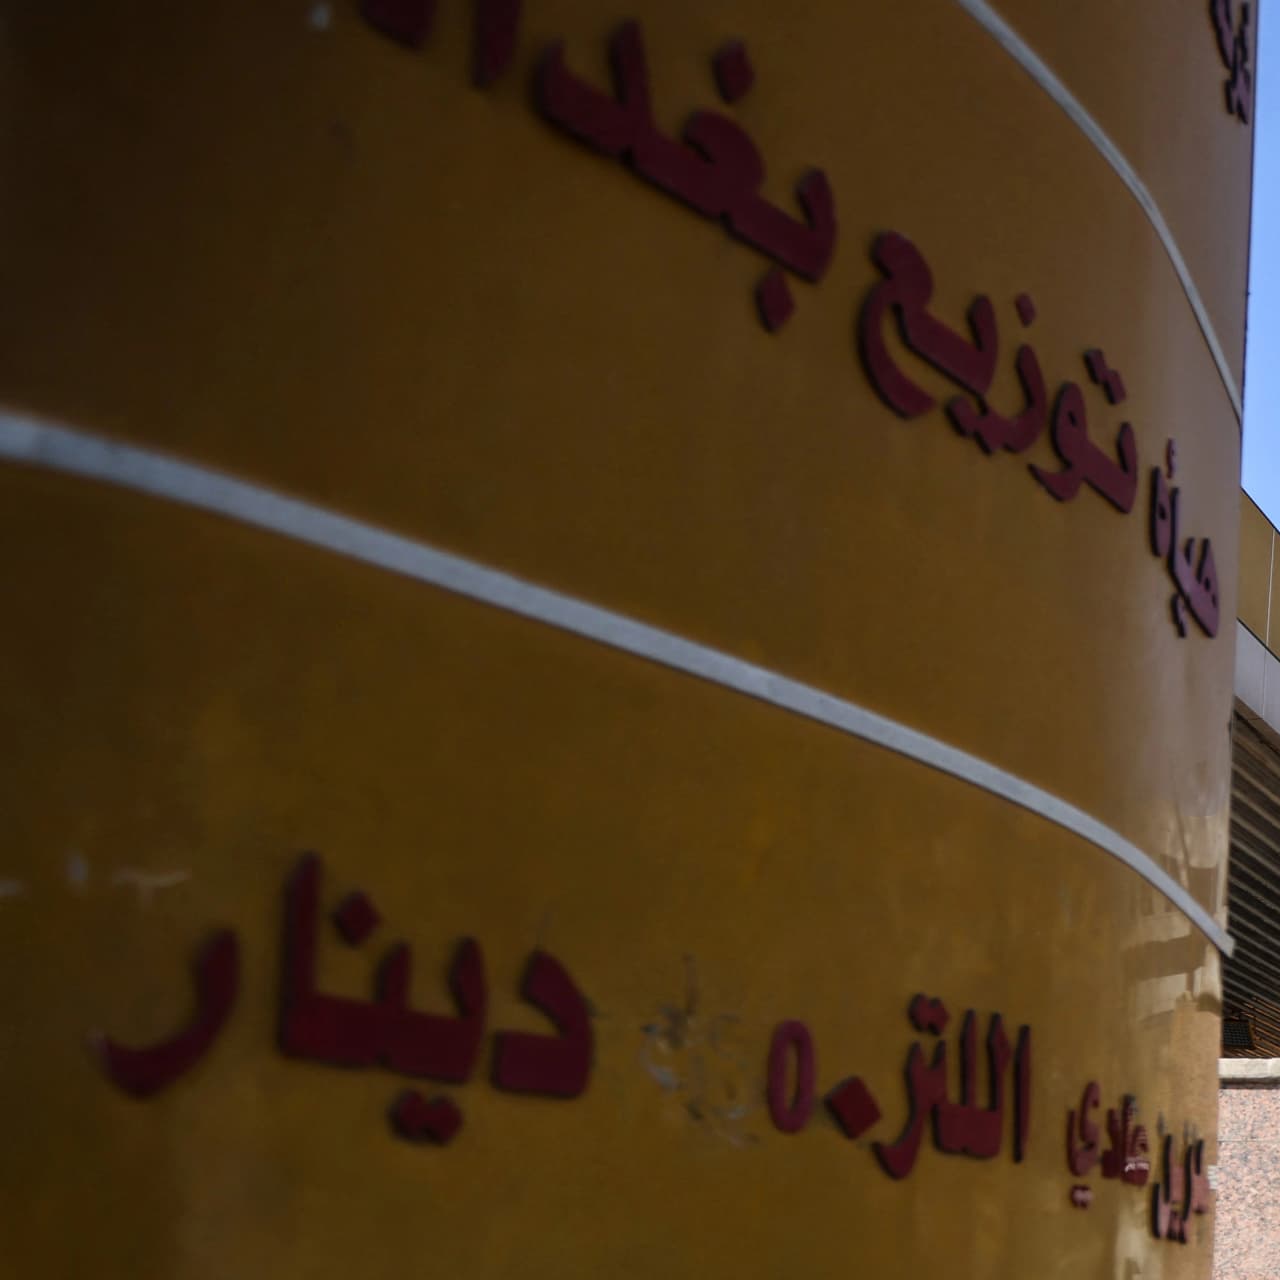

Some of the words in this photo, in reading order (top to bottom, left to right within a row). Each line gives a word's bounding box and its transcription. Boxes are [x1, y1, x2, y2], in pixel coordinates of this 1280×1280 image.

[859, 231, 1139, 513] توزيع
[97, 850, 594, 1144] دينار
[875, 992, 1032, 1181] اللتر
[1065, 1080, 1150, 1210] عادي
